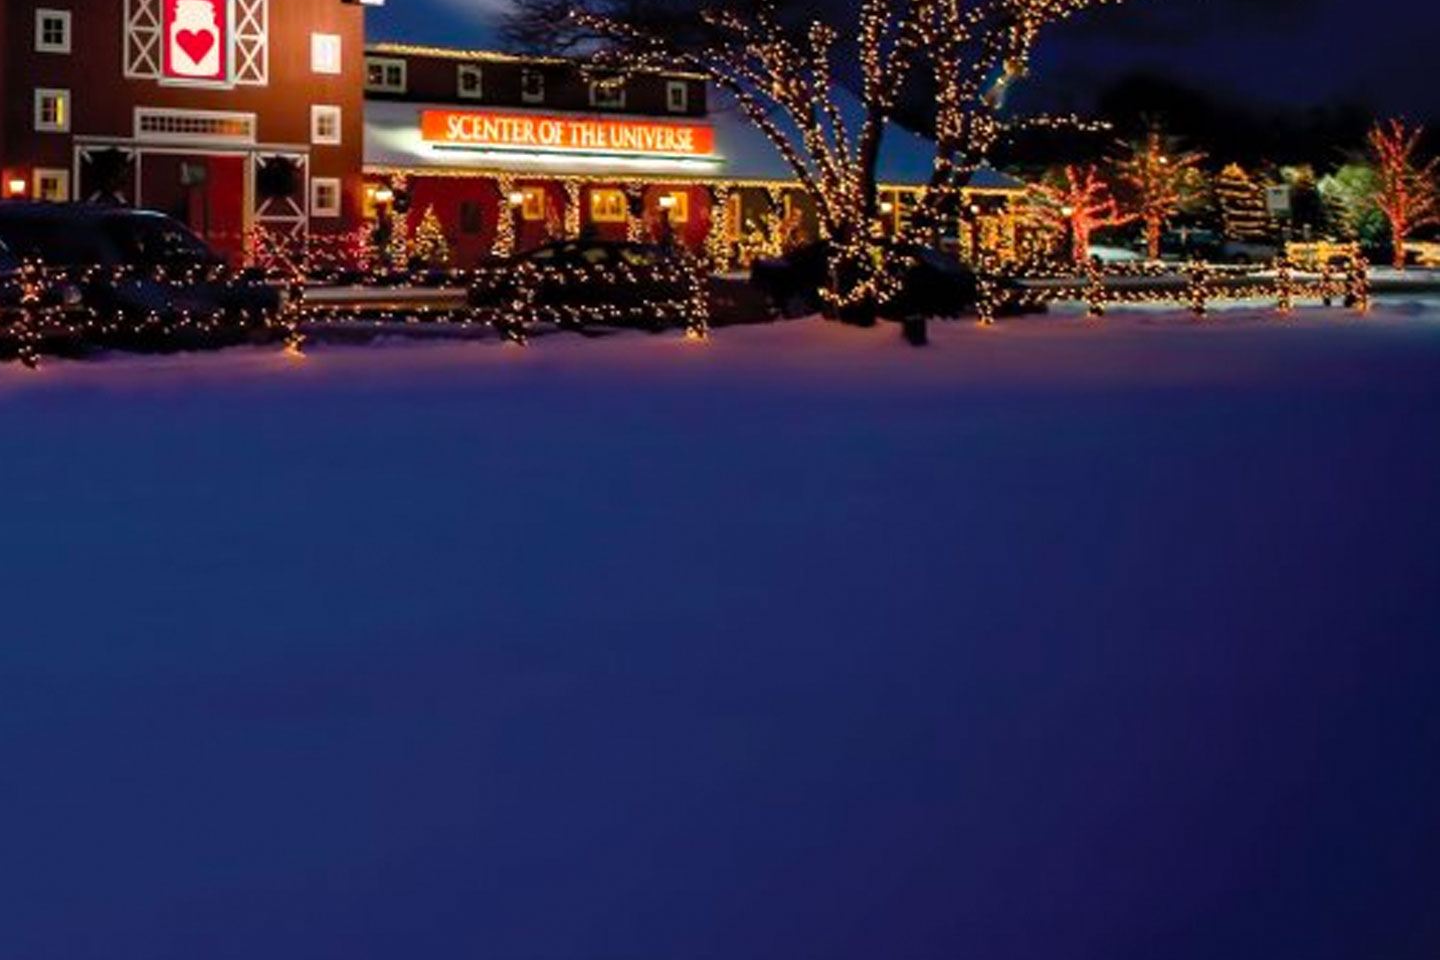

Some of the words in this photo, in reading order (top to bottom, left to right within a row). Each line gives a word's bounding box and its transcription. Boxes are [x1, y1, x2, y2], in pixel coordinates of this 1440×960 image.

[446, 115, 535, 143] SCENTER
[539, 120, 564, 144] OF
[569, 123, 606, 147] THE
[611, 125, 694, 151] UNIVERSE
